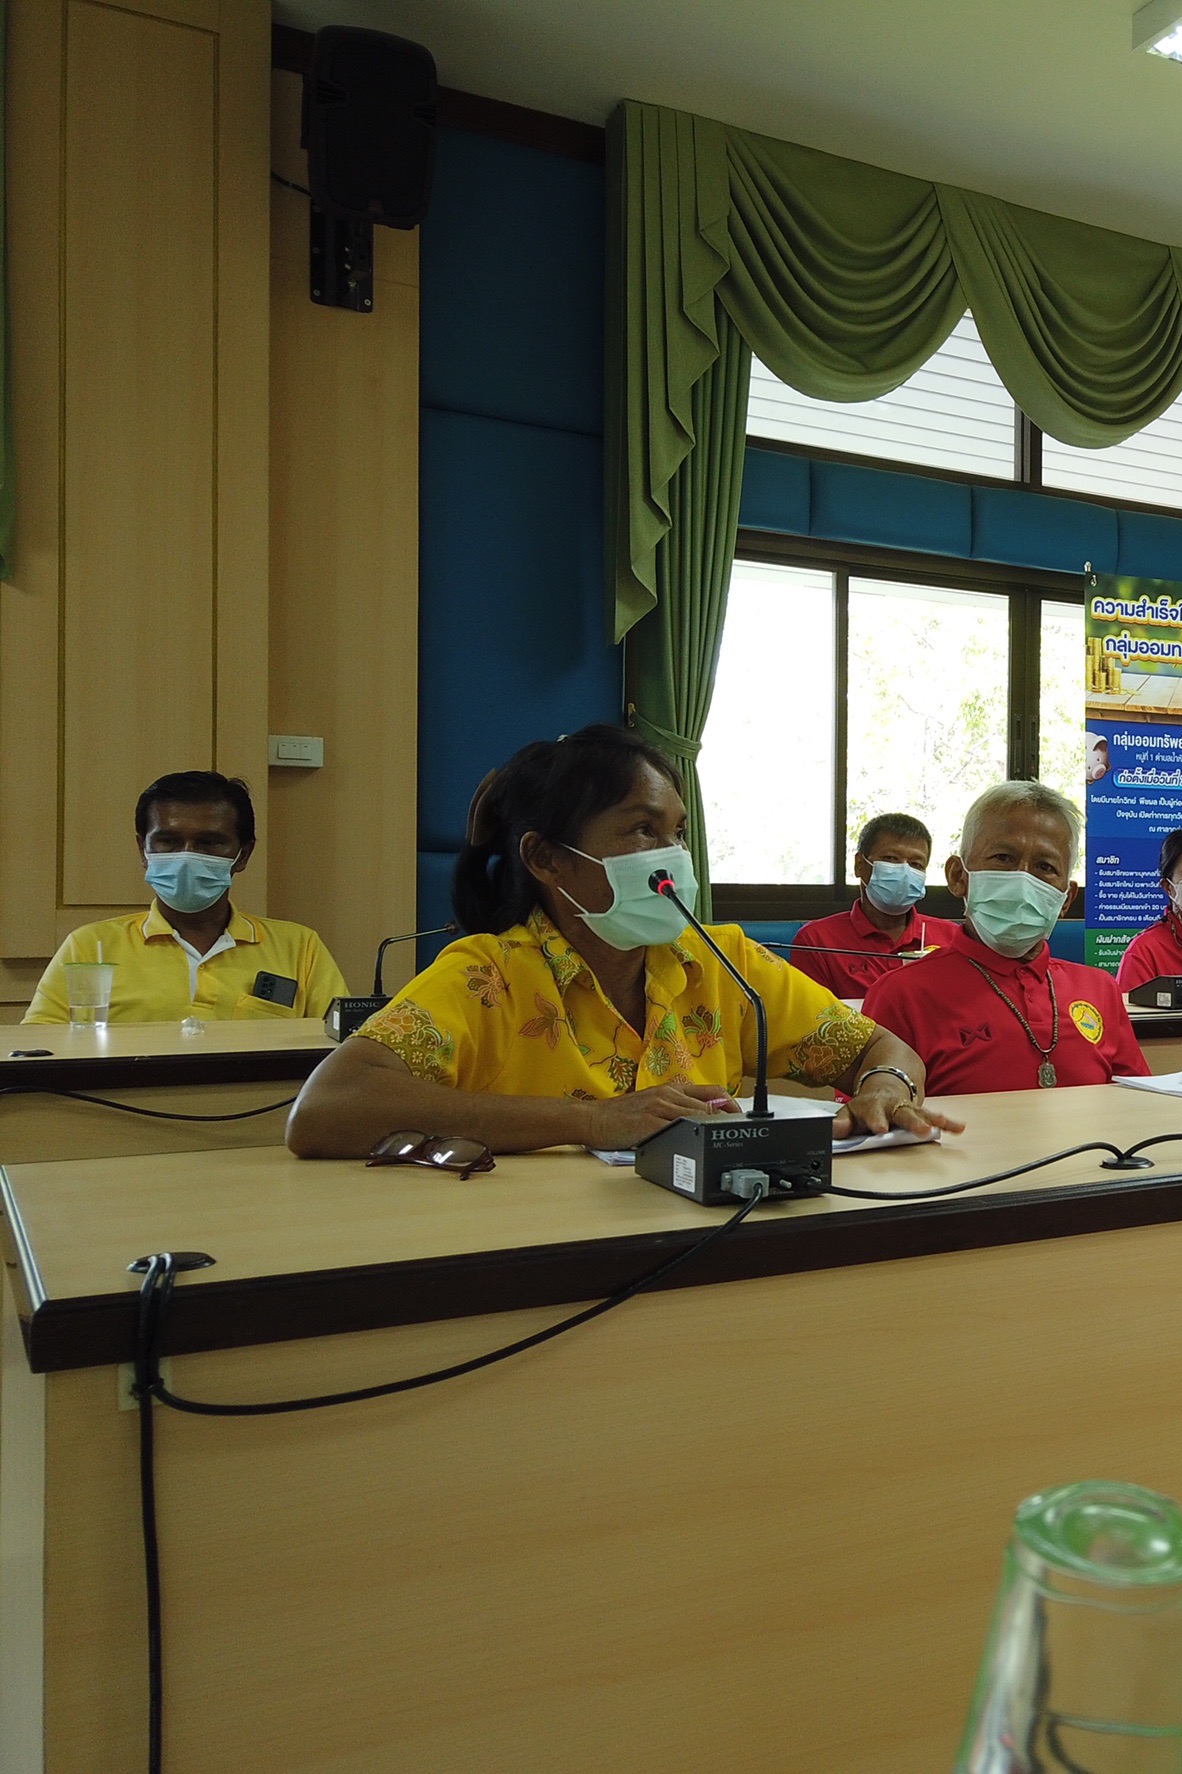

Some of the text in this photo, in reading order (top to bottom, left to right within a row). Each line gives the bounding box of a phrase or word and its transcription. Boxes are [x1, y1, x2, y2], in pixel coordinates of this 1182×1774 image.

[1119, 767, 1180, 785] ก่อตั้งเมื่อวันที่
